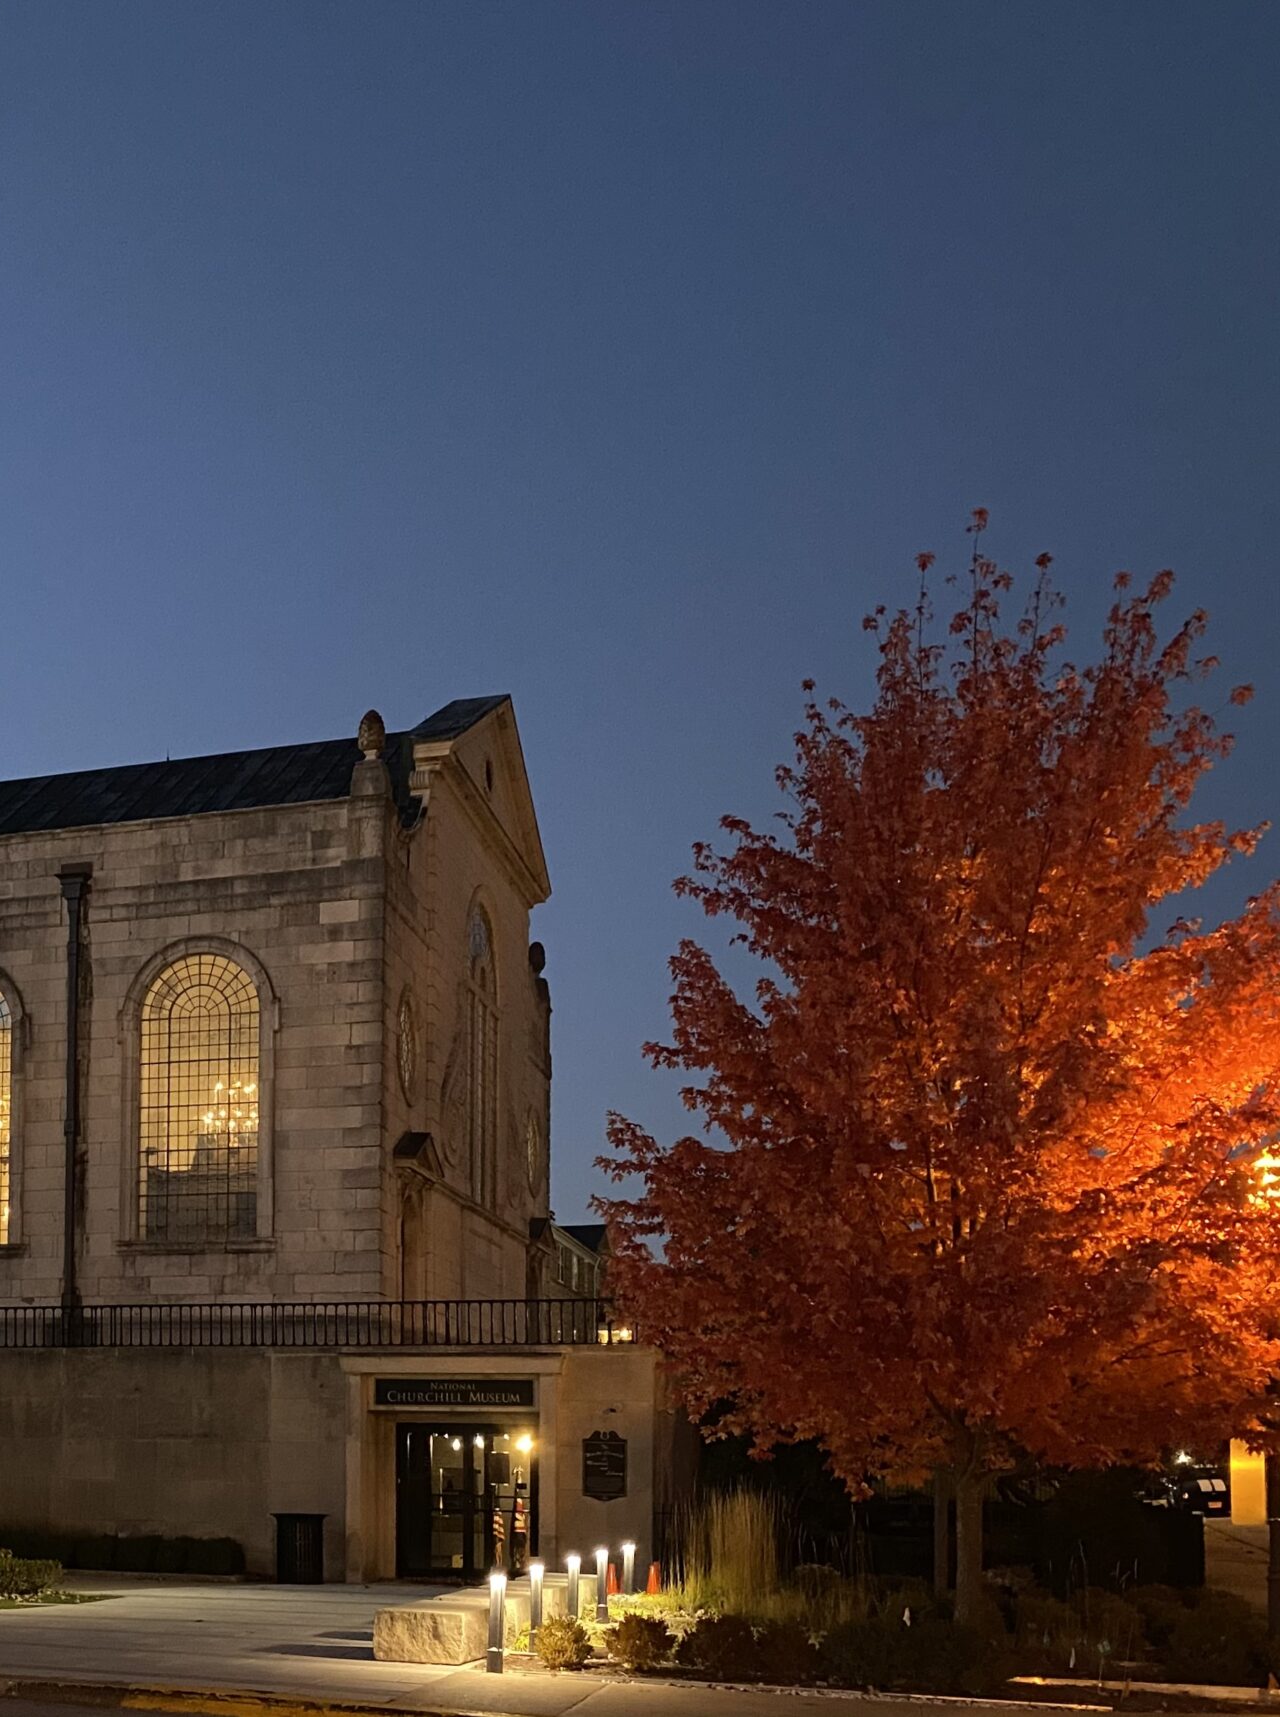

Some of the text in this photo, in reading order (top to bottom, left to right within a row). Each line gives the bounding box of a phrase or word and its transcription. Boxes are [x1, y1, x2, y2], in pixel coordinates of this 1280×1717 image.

[430, 1382, 476, 1391] NATIONAL
[387, 1390, 521, 1404] CHURCHILL MUSEUM
